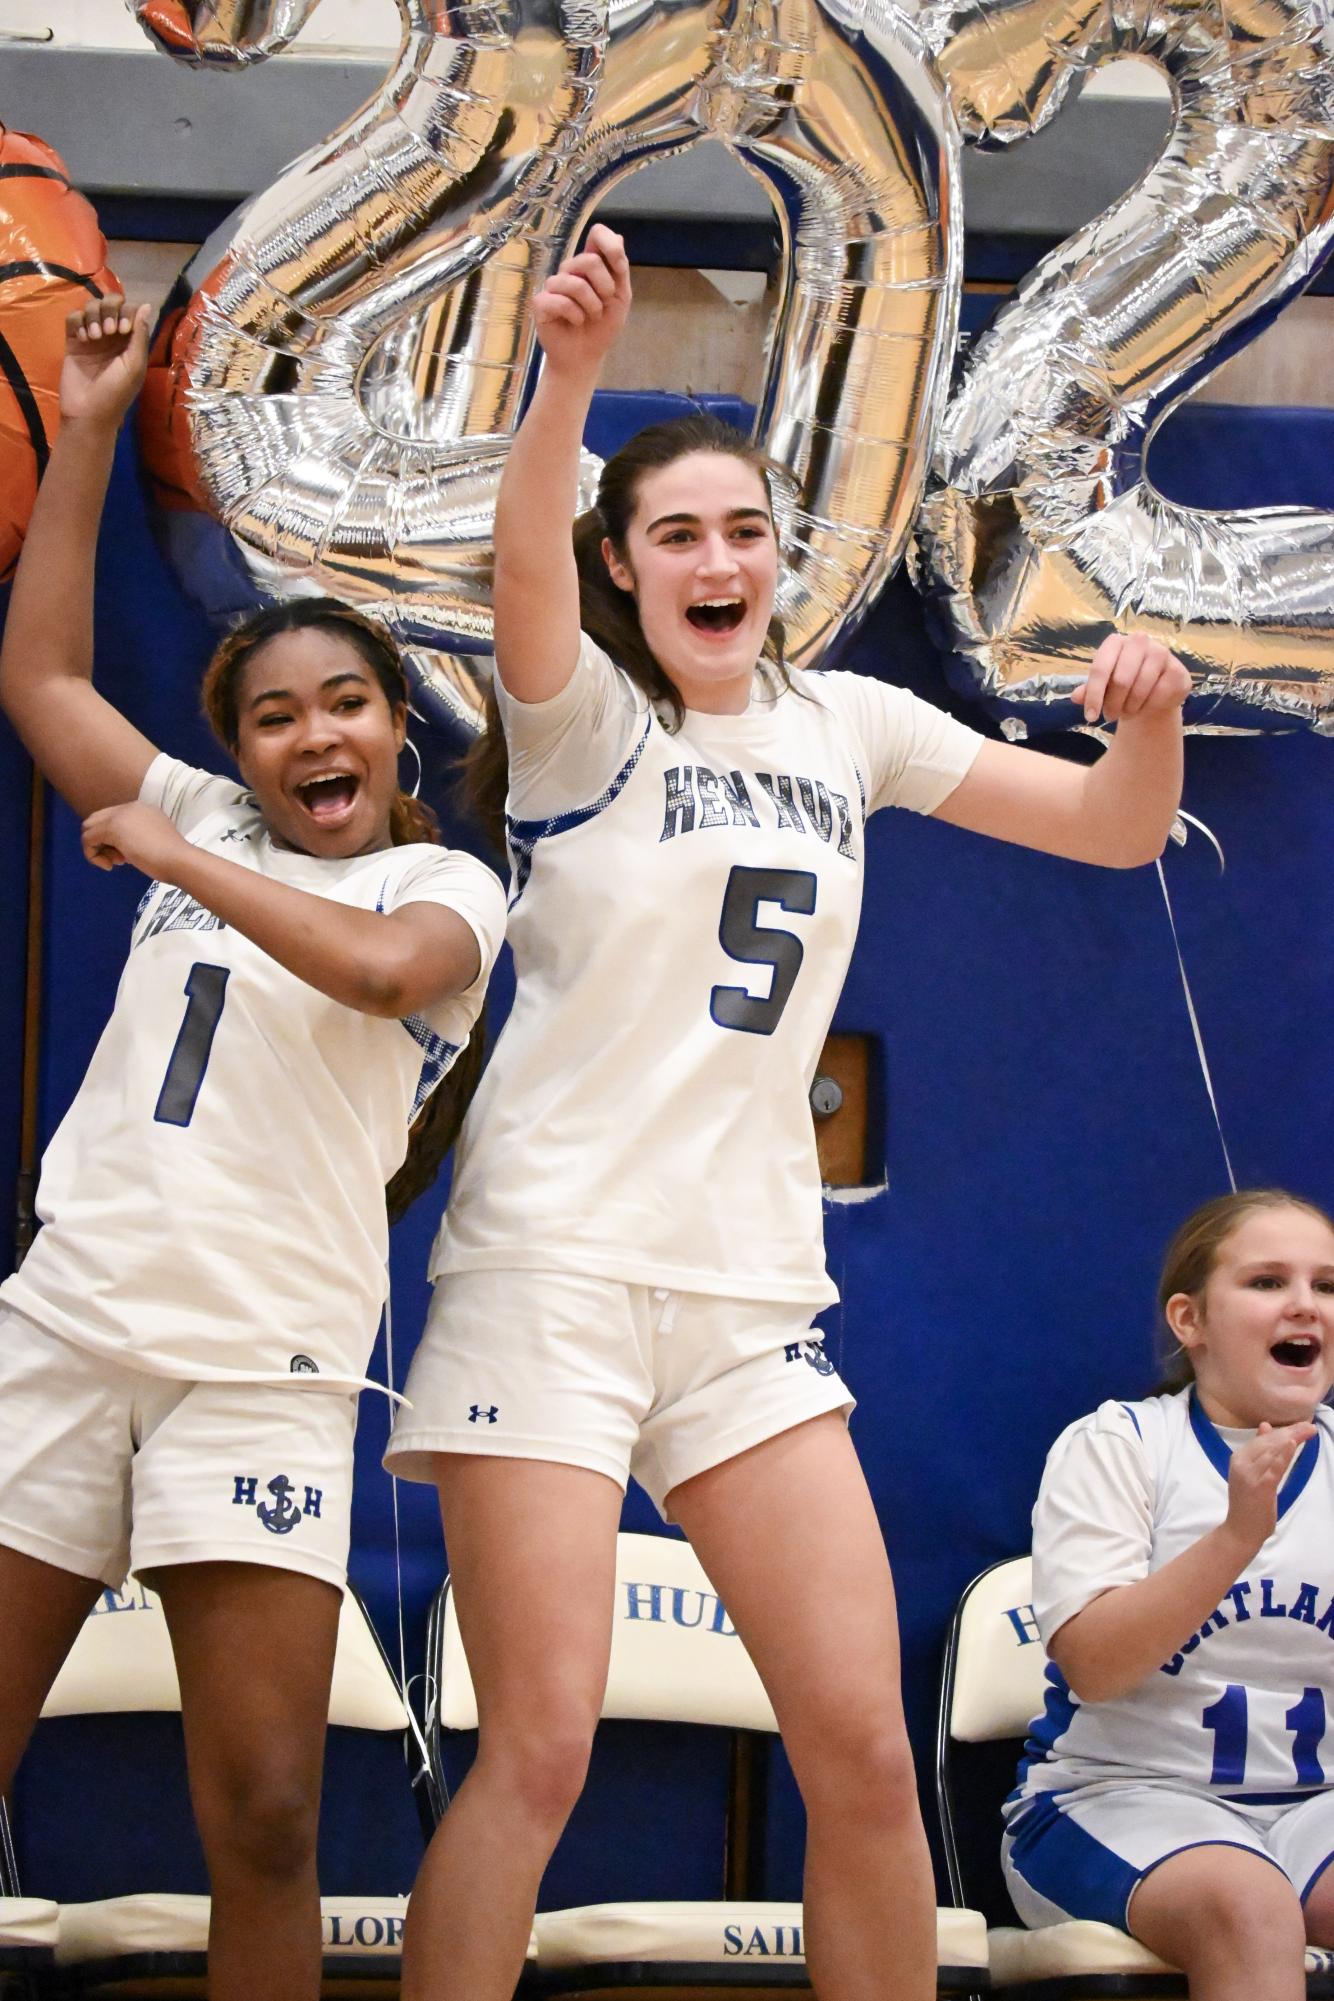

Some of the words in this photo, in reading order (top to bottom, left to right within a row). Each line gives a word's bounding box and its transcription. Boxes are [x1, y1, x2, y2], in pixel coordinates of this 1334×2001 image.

[659, 766, 761, 843] HEN
[709, 864, 818, 1036] 5
[154, 962, 230, 1127] 1
[1202, 1684, 1326, 1785] 11
